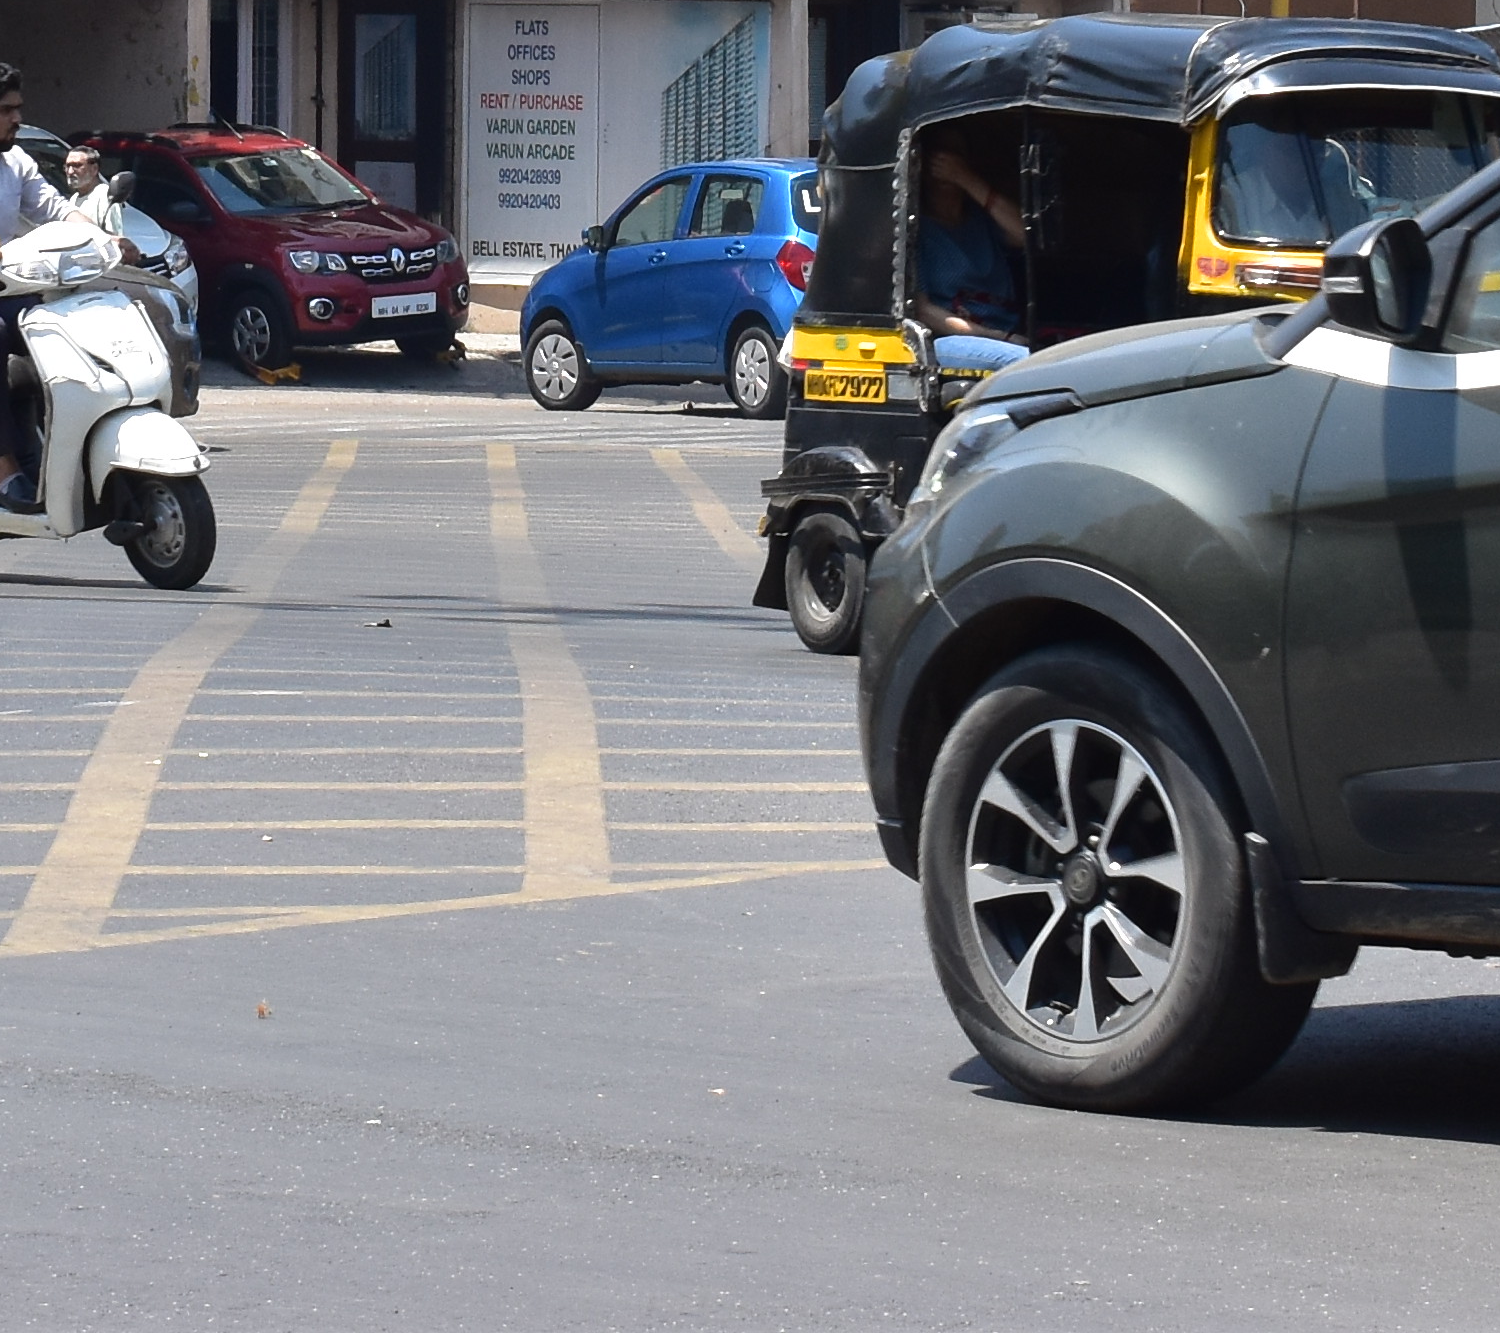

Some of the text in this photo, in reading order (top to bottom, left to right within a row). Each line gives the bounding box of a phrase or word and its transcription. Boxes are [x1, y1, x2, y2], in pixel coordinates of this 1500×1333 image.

[515, 20, 549, 35] FLATS
[507, 44, 556, 61] OFFICES
[511, 69, 551, 85] SHOPS
[480, 93, 510, 109] RENT
[519, 94, 584, 110] PURCHASE
[486, 118, 576, 135] VARUN GARDEN
[486, 142, 576, 160] VARUN ARCADE
[498, 192, 561, 209] 9920420403
[472, 240, 500, 257] BELL
[502, 241, 546, 259] ESTATE,
